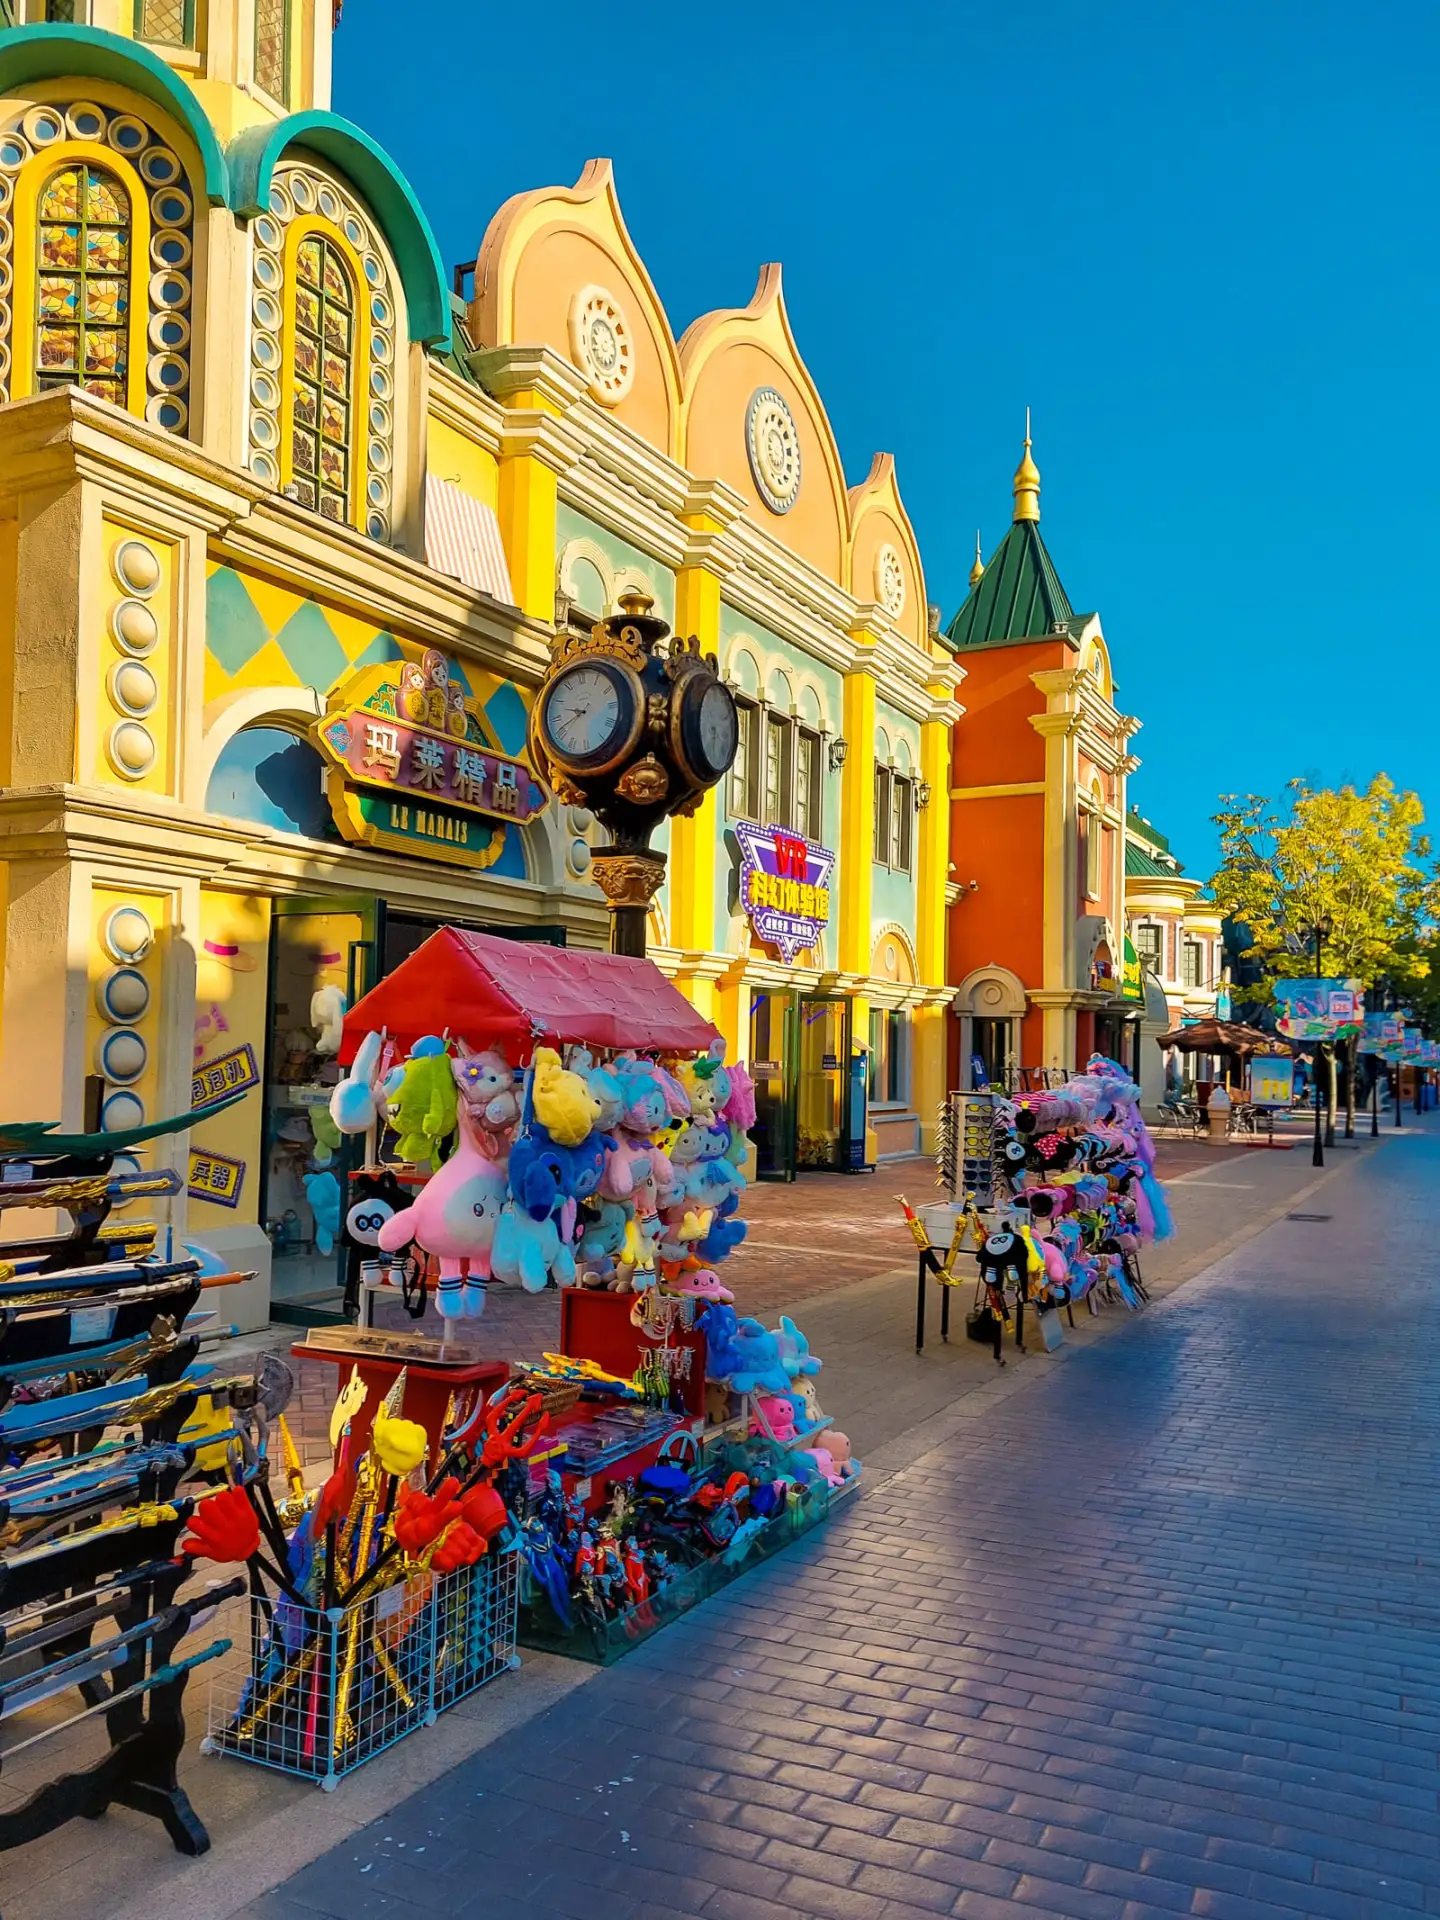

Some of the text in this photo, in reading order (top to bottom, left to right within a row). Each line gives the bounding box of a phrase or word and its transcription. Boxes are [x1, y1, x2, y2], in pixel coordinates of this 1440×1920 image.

[362, 723, 520, 813] 玛莱精品
[391, 804, 467, 844] LE MARAIS
[775, 834, 807, 880] VR
[749, 870, 829, 921] 科幻体验馆
[191, 1160, 228, 1189] 兵器
